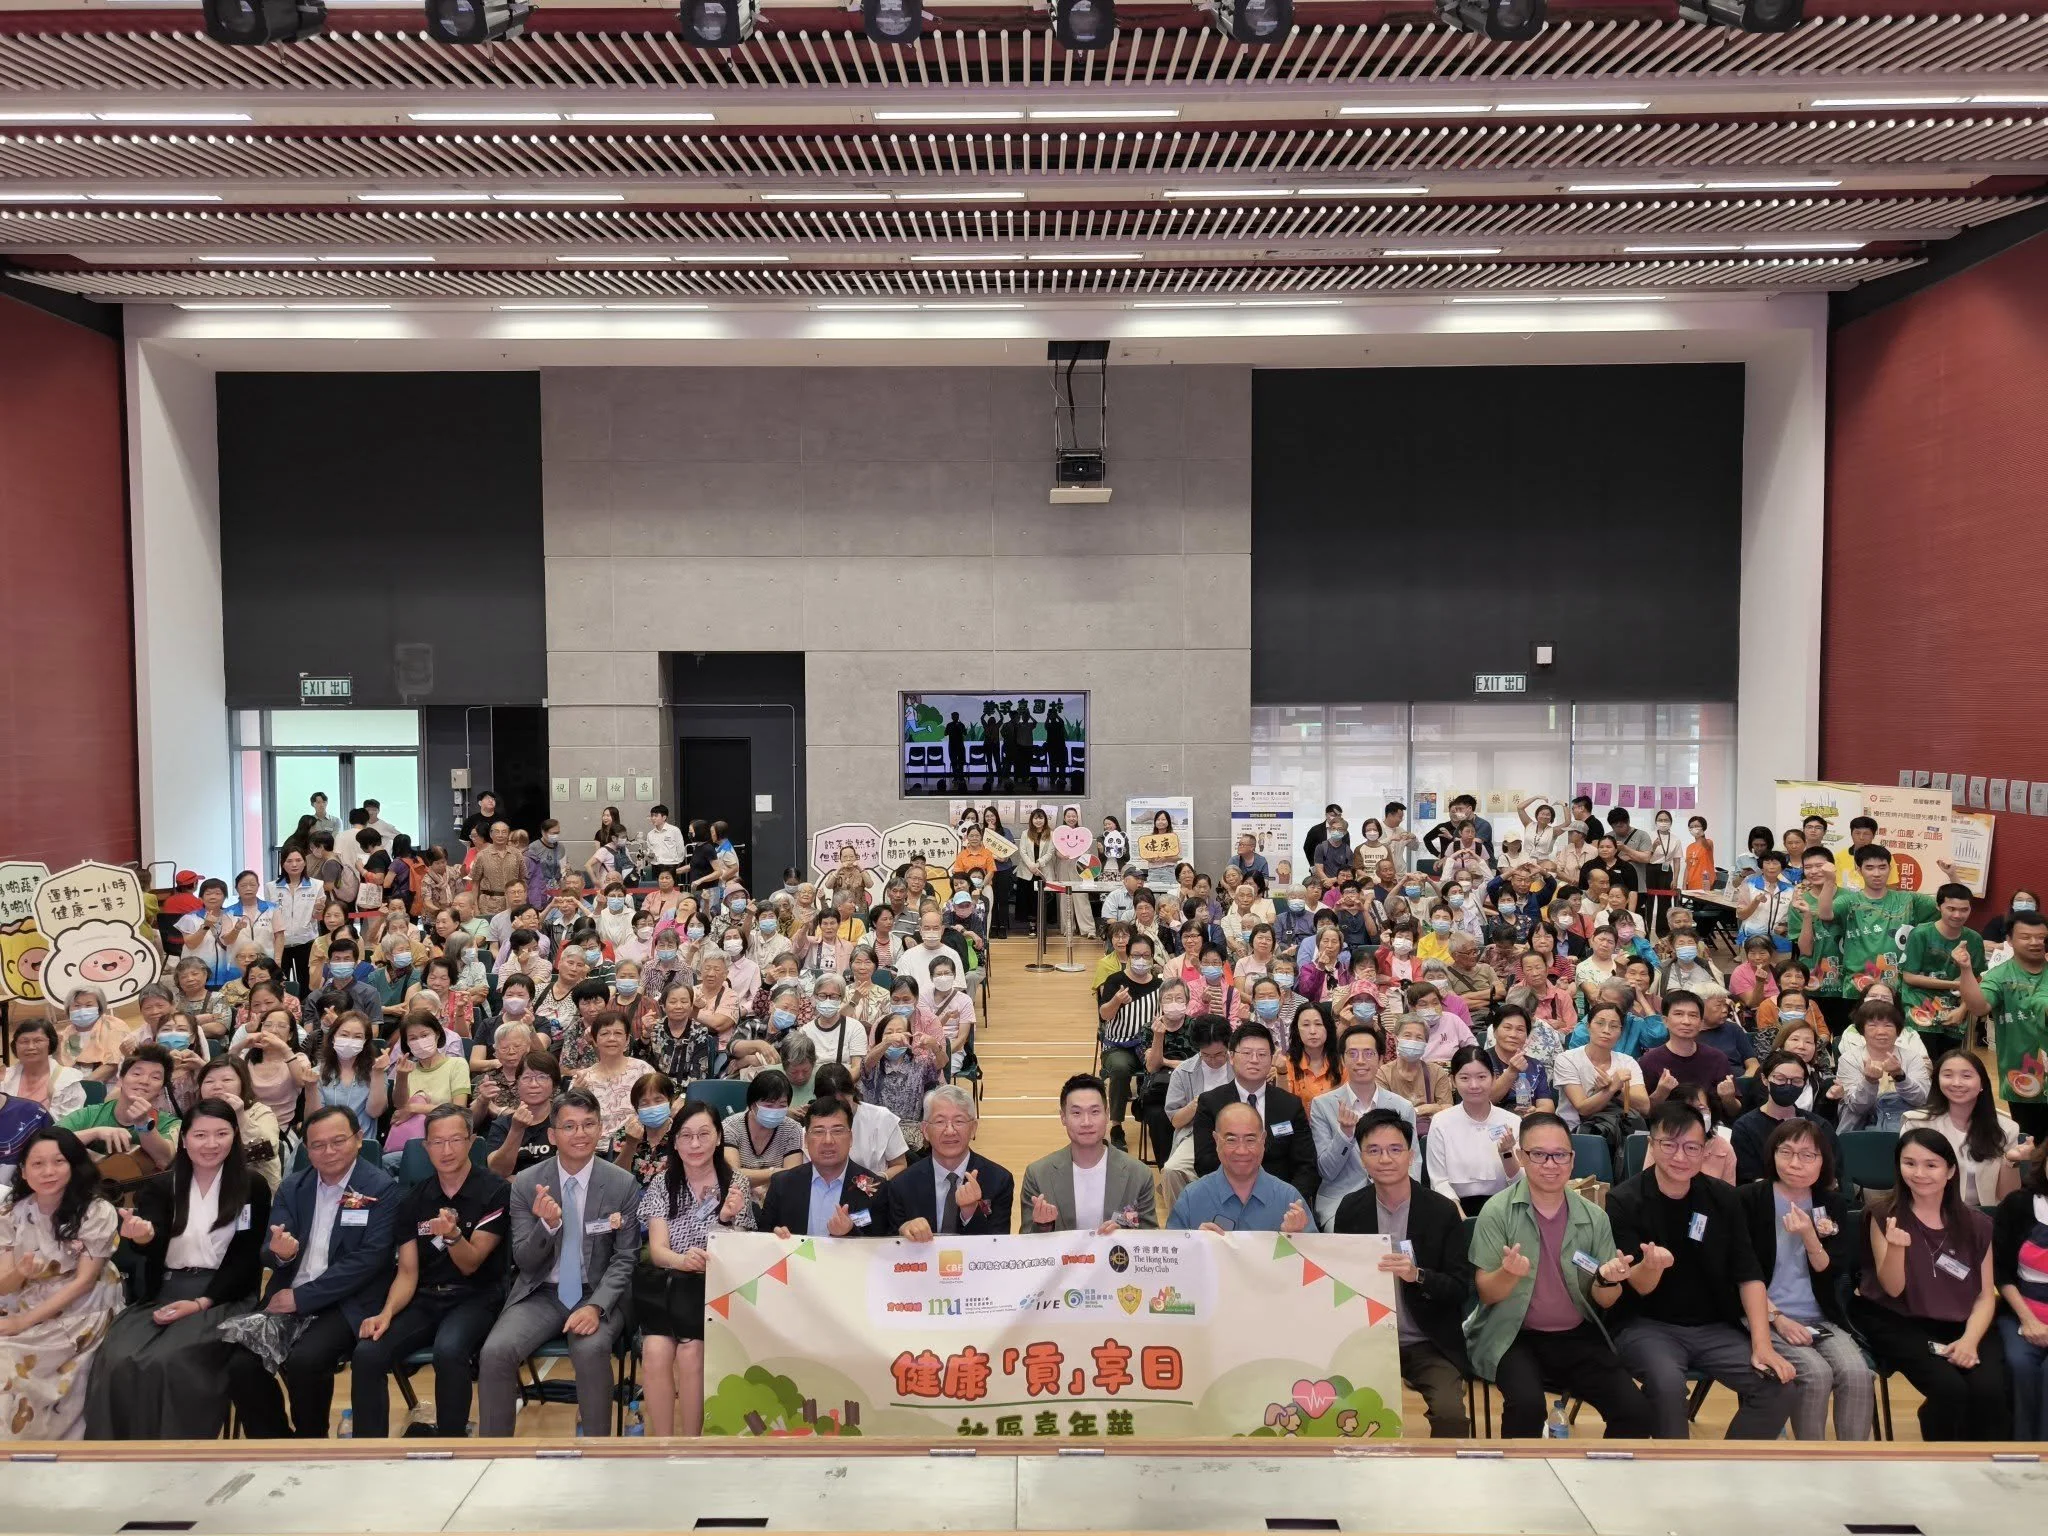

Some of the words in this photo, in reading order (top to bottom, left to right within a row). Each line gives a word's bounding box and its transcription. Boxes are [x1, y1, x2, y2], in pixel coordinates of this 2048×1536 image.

[303, 681, 326, 695] EXIT
[331, 681, 349, 695] 出口
[1476, 676, 1501, 690] EXIT
[1505, 676, 1524, 690] 出口
[48, 878, 127, 903] 運動一小時
[51, 897, 125, 920] 健康一輩子
[1133, 1246, 1178, 1254] 香港賽馬會
[1146, 1256, 1162, 1264] Hong
[1163, 1256, 1178, 1265] Kong
[1134, 1264, 1154, 1274] Jockey
[1155, 1264, 1169, 1273] Club
[1036, 1299, 1060, 1310] IVE
[890, 1338, 1183, 1401] 健康「貢」享日
